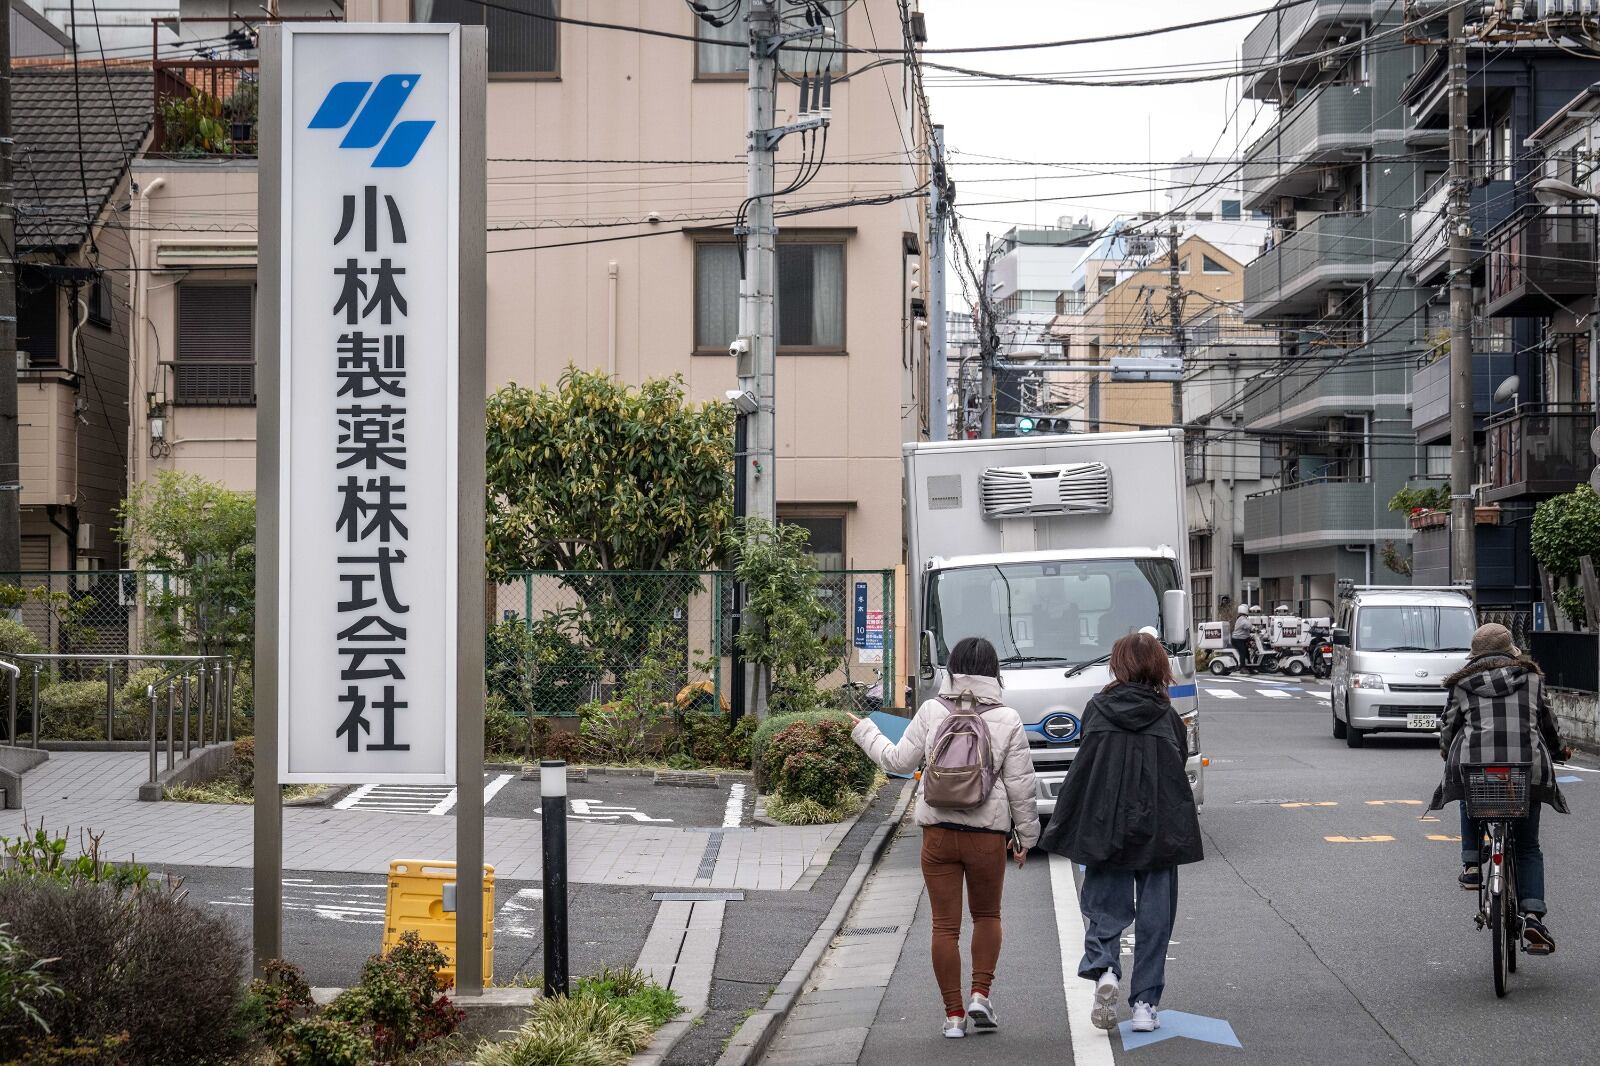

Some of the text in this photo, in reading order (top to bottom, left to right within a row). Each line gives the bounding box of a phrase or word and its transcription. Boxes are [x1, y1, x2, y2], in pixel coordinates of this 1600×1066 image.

[333, 185, 411, 753] 小林製薬株式会社
[856, 626, 865, 634] 10
[1413, 719, 1435, 728] 55-92
